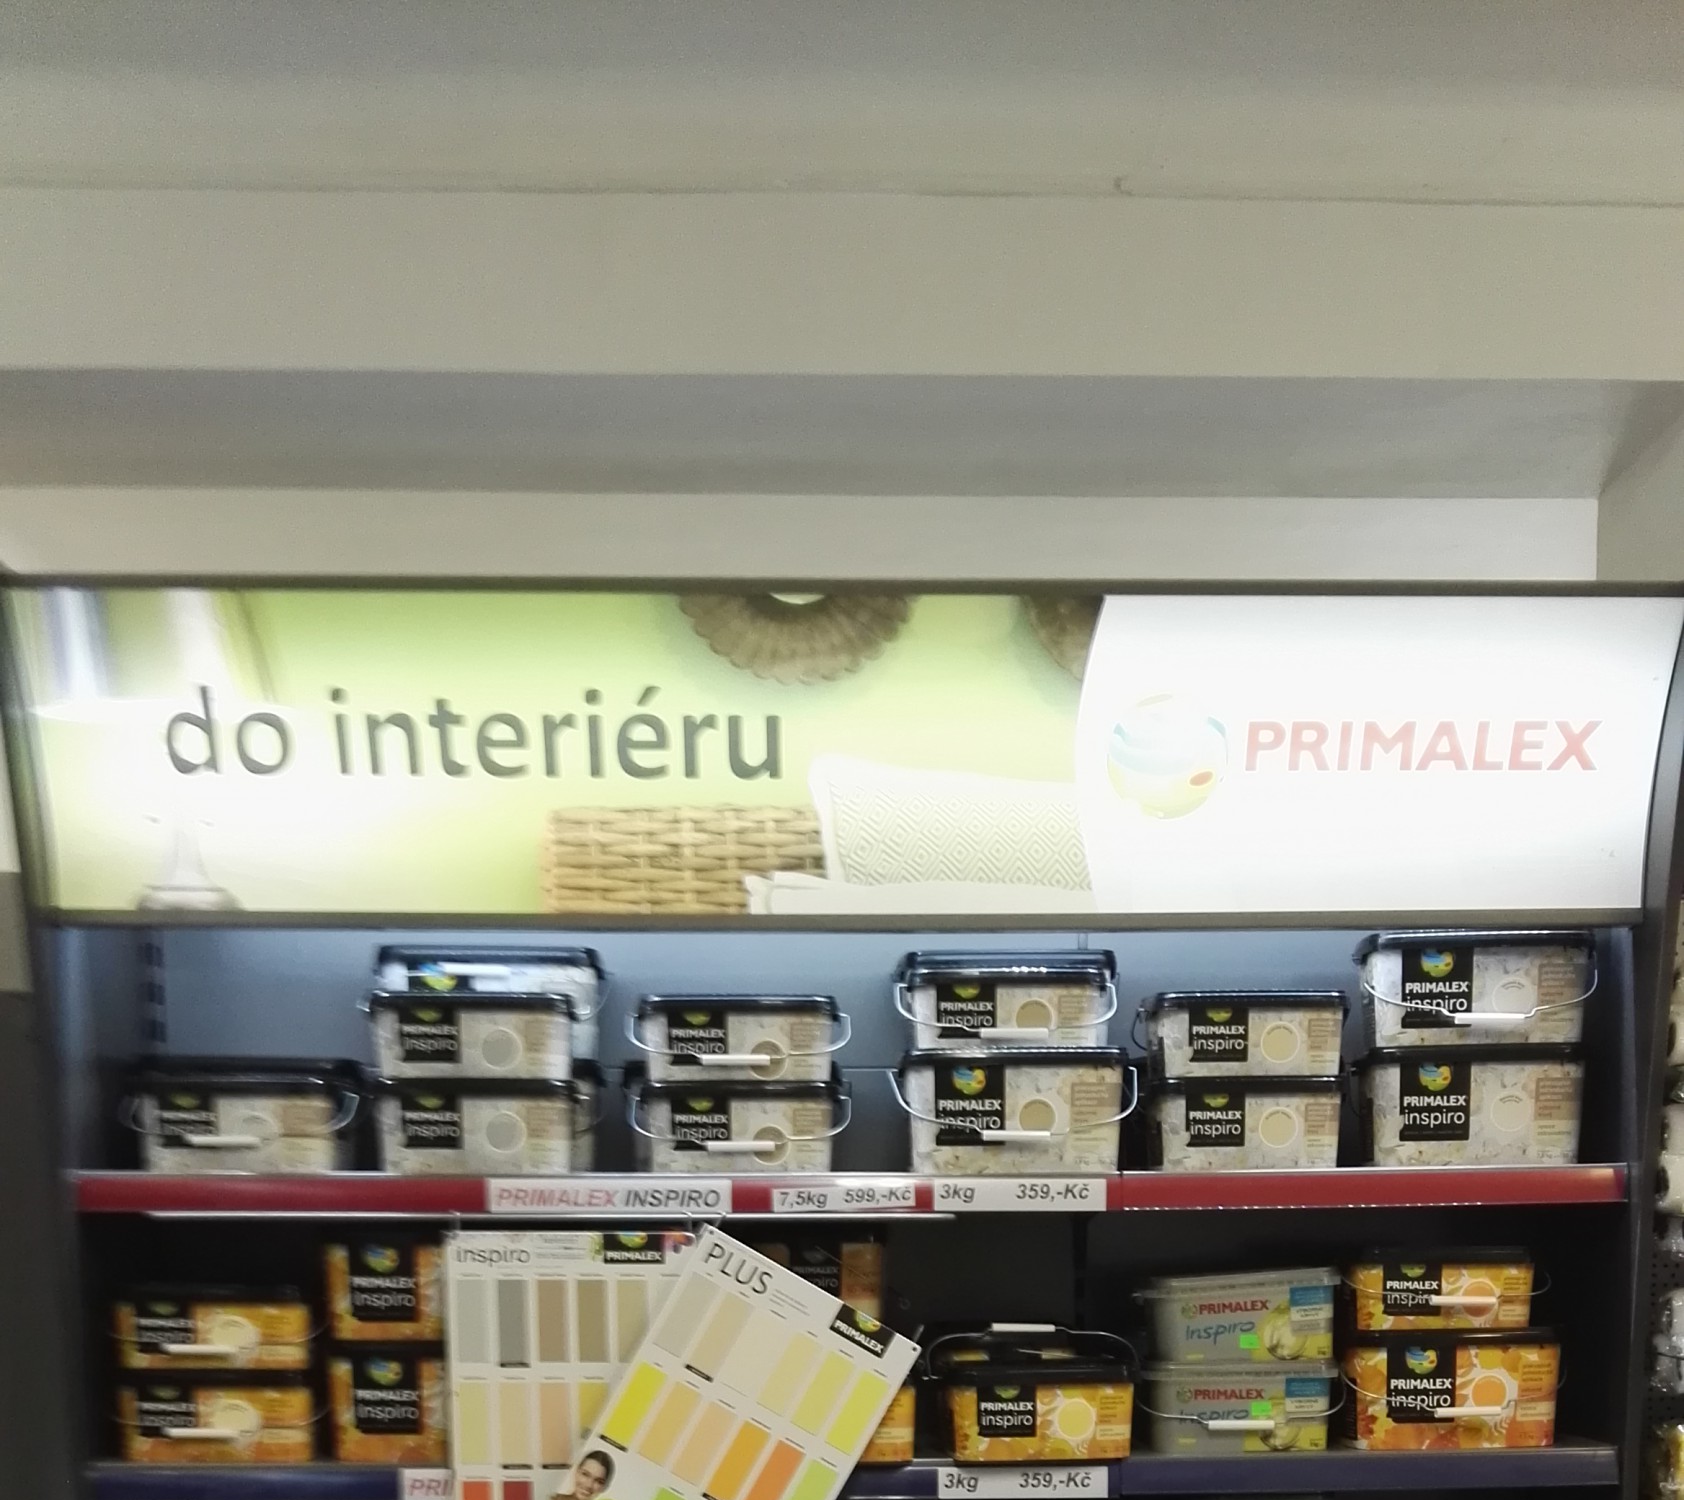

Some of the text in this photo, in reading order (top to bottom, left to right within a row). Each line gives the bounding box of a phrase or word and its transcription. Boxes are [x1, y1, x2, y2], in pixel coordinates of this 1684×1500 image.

[166, 685, 783, 779] do interiéru
[1245, 719, 1602, 772] PRIMALEX
[1405, 981, 1469, 993] PRIMALEX
[940, 1002, 994, 1012] PRIMALEX
[1406, 995, 1468, 1015] inspiro
[941, 1012, 993, 1029] inspiro
[672, 1029, 726, 1039] PRIMALEX
[1192, 1025, 1245, 1034] PRIMALEX
[672, 1040, 725, 1055] inspiro
[1193, 1037, 1244, 1052] inspiro
[938, 1100, 1002, 1112] PRIMALEX
[1403, 1095, 1467, 1107] PRIMALEX
[674, 1114, 728, 1124] PRIMALEX
[939, 1113, 1001, 1133] inspiro
[1189, 1110, 1242, 1120] PRIMALEX
[1404, 1109, 1466, 1129] inspiro
[675, 1125, 728, 1141] inspiro
[1190, 1122, 1242, 1138] inspiro
[497, 1189, 721, 1208] PRIMALEX INSPIRO
[778, 1187, 912, 1209] 7,5kg 599,-Kč
[939, 1183, 1090, 1203] 3kg 359,-Kč
[456, 1246, 531, 1268] inspiro
[605, 1251, 663, 1262] PRIMALEX
[704, 1242, 773, 1294] PLUS
[1386, 1281, 1439, 1290] PRIMALEX
[1199, 1300, 1270, 1315] PRIMALEX
[833, 1319, 885, 1354] PRIMALEX
[1390, 1378, 1453, 1390] PRIMALEX
[1194, 1388, 1265, 1400] PRIMALEX
[1391, 1392, 1451, 1410] inspiro
[980, 1402, 1034, 1412] PRIMALEX
[981, 1413, 1033, 1429] inspiro
[944, 1471, 1092, 1492] 3kg 359,-Kč
